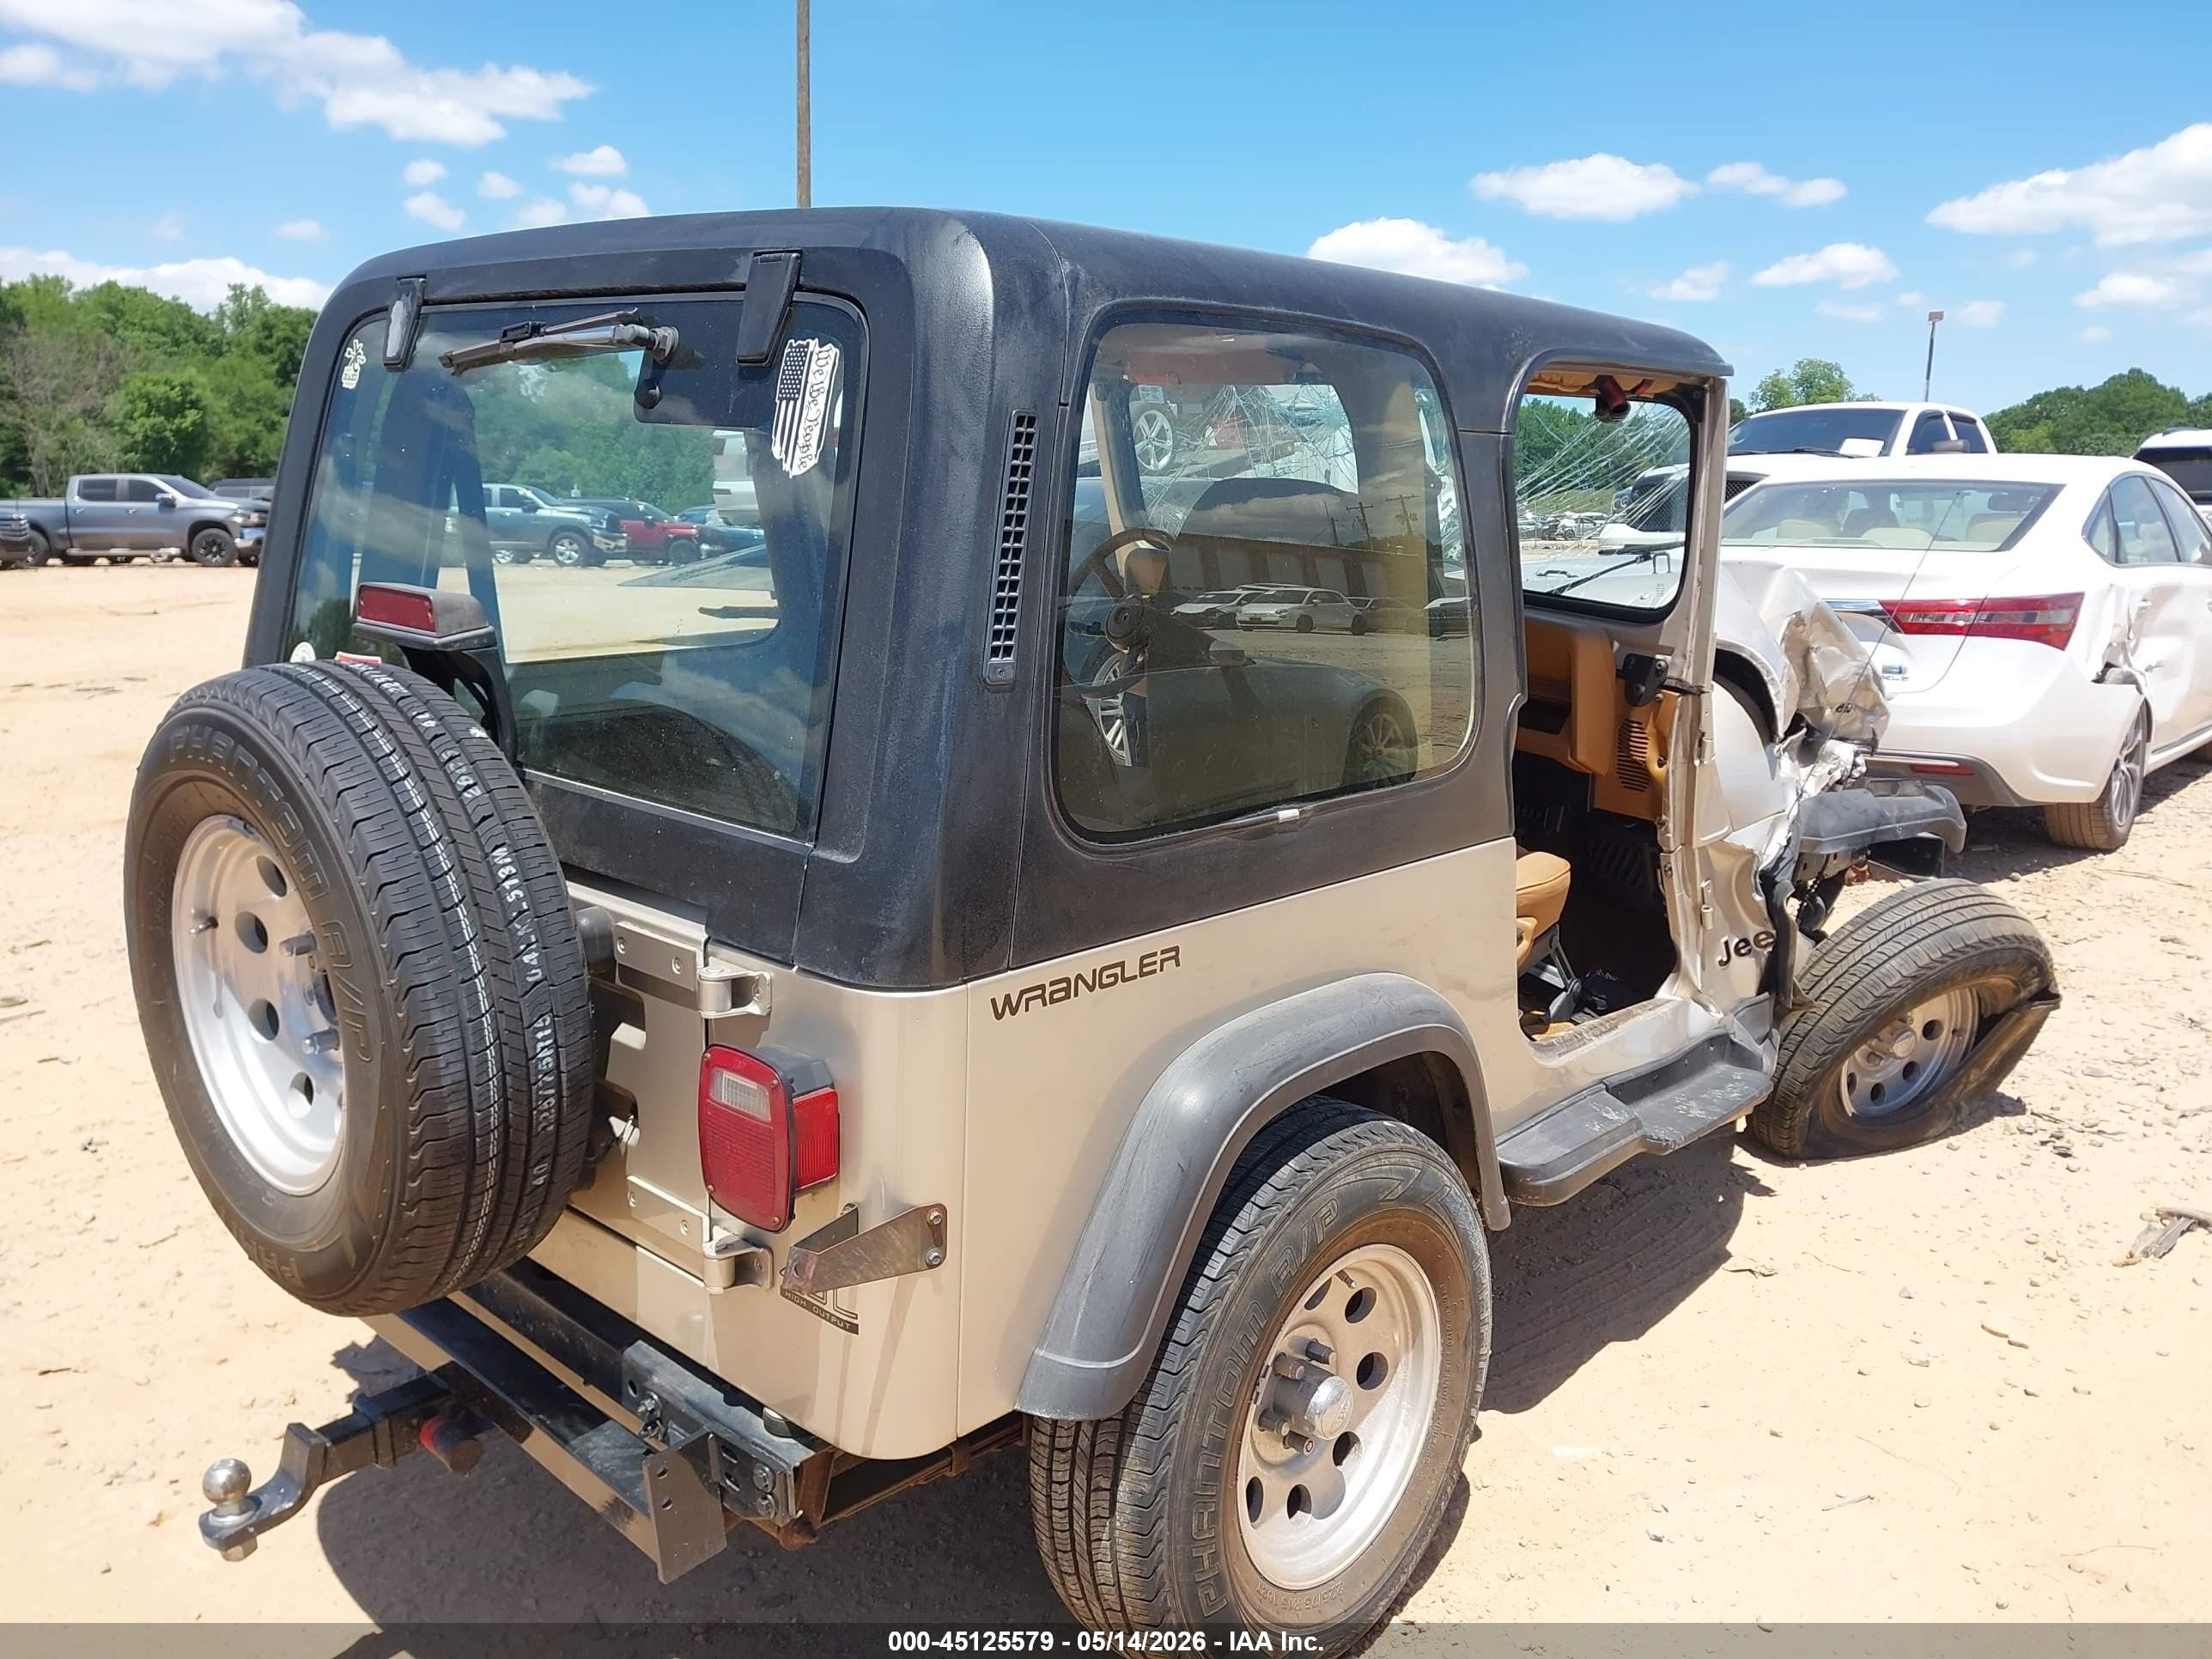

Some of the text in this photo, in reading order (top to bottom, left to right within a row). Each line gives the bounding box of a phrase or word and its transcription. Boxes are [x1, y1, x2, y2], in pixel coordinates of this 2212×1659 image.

[168, 724, 331, 902] PHANTOM
[989, 945, 1182, 1021] WRANGLER
[1717, 931, 1775, 967] Jee
[783, 1291, 807, 1308] HIGH
[813, 1307, 852, 1330] OUTPUT
[1191, 1199, 1339, 1620] PHANTOM A/P
